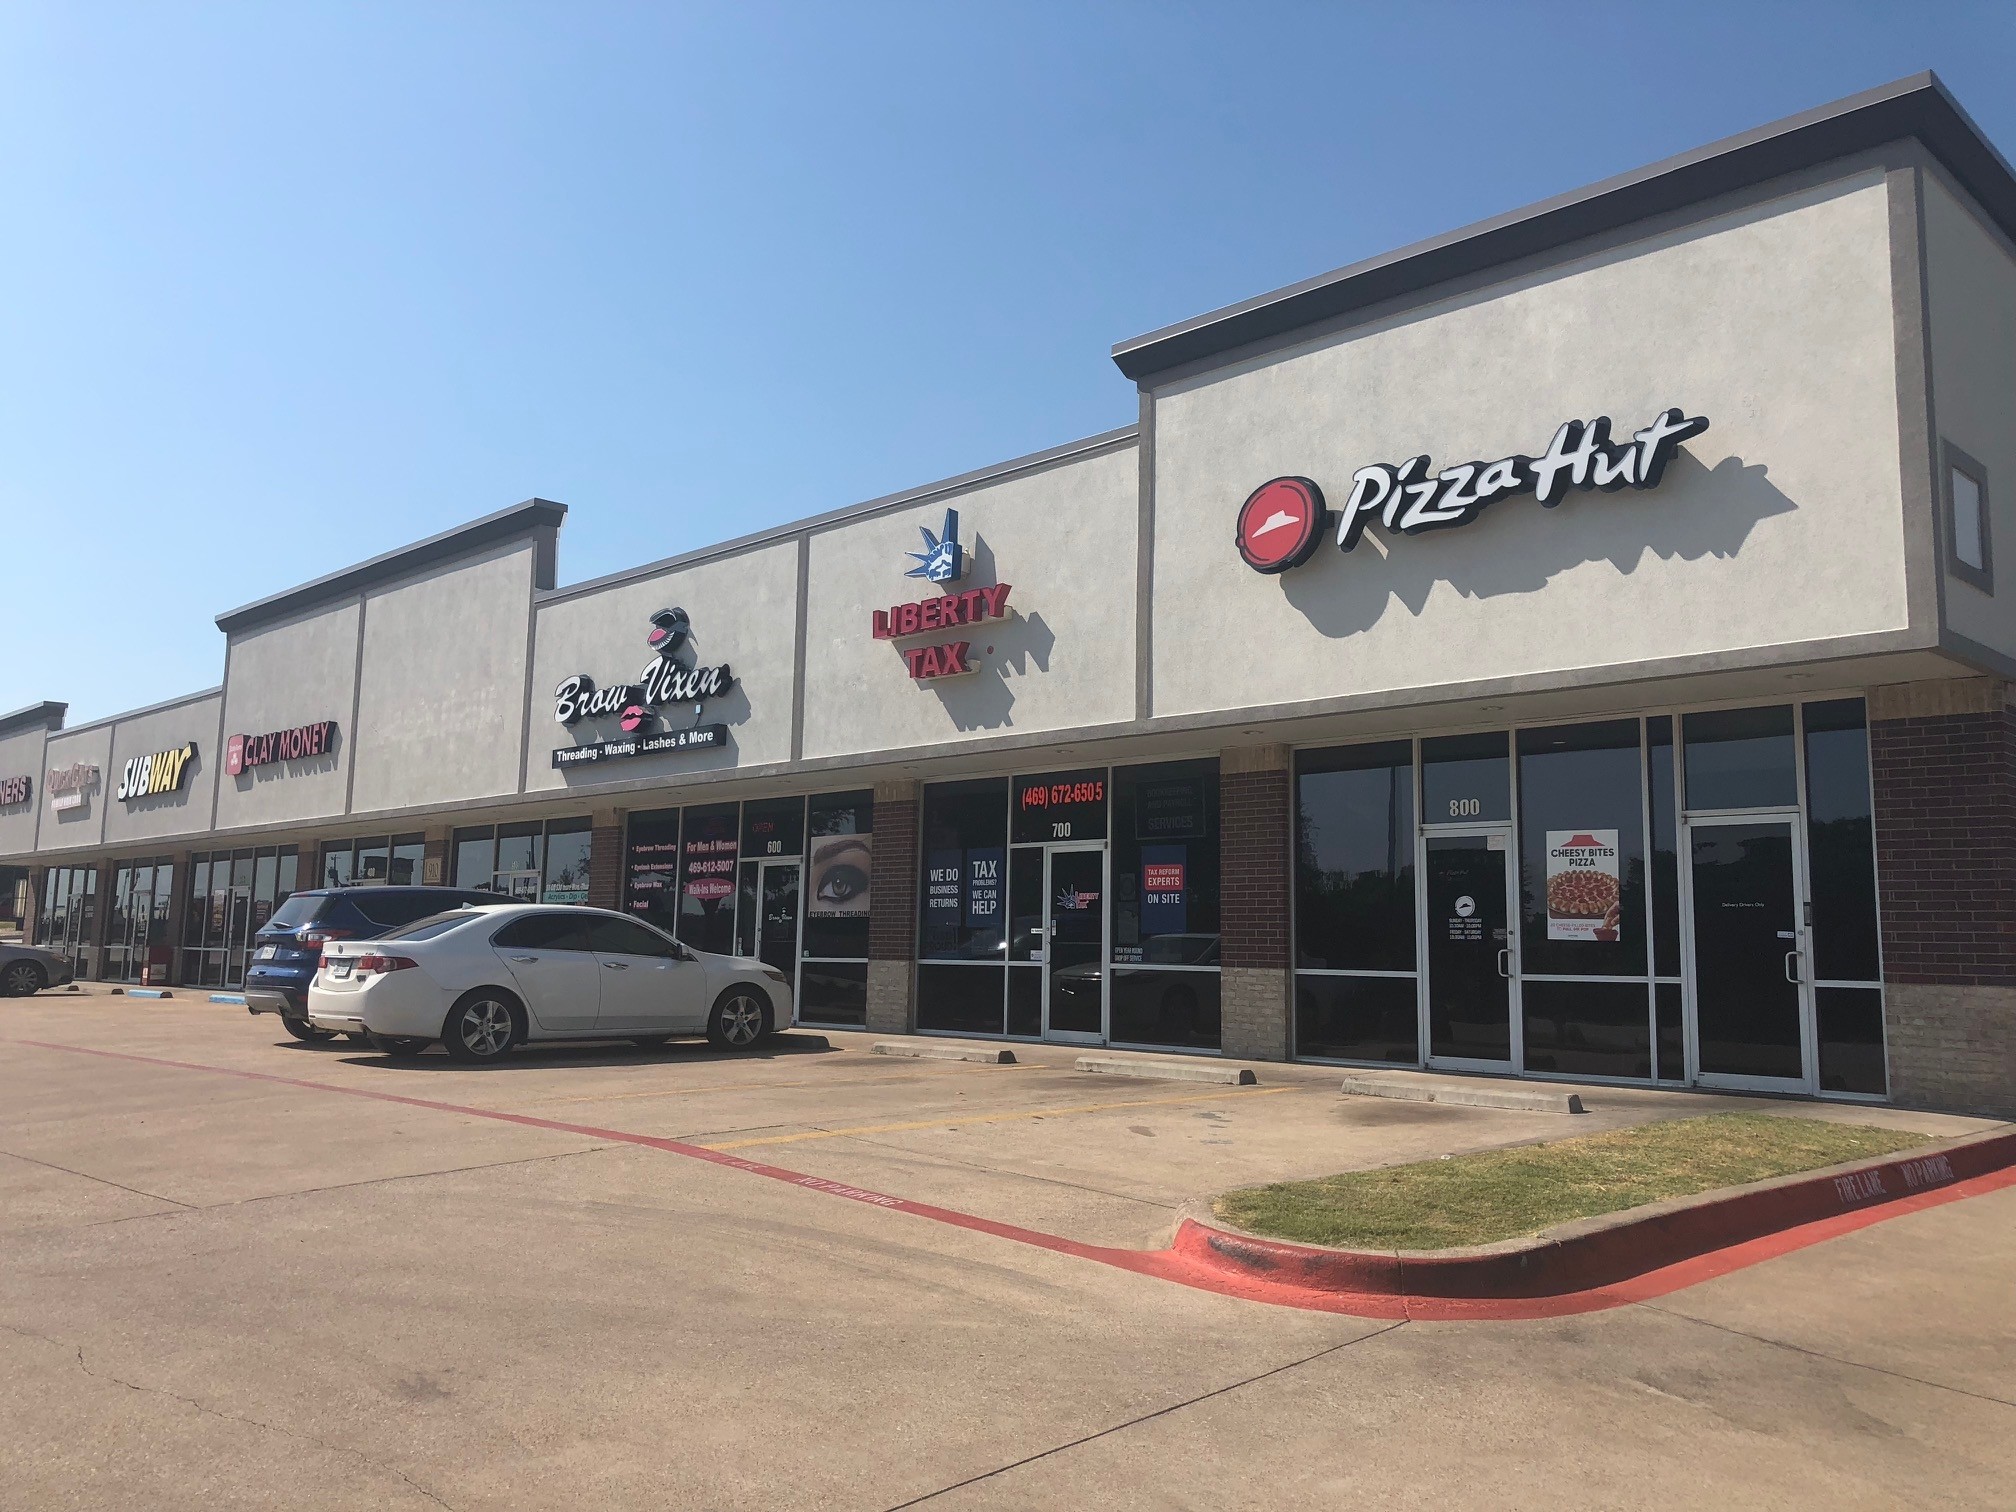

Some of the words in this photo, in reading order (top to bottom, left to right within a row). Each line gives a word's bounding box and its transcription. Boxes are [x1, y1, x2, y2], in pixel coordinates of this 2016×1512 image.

[1337, 457, 1523, 548] Pizza
[1529, 411, 1698, 502] Hut
[873, 583, 1009, 639] LIBERTY
[904, 641, 967, 678] TAX
[554, 675, 628, 723] Brow
[640, 655, 722, 705] Vixen
[245, 733, 275, 766] CLAY
[279, 721, 330, 760] MONEY
[556, 749, 598, 762] Threading
[605, 742, 636, 756] Waxing
[643, 736, 676, 750] Lashes
[679, 733, 686, 745] &
[689, 731, 714, 744] More
[118, 742, 194, 800] SUBWAY
[1022, 786, 1048, 811] (469)
[1052, 782, 1103, 804] 672-6505
[1450, 799, 1480, 816] 800
[1052, 822, 1071, 838] 700
[687, 842, 696, 852] For
[697, 842, 709, 851] Men
[716, 841, 737, 850] Women
[767, 841, 782, 853] 600
[1551, 849, 1586, 857] CHEESY
[1588, 848, 1614, 857] BITES
[973, 860, 997, 878] TAX
[1569, 858, 1595, 866] PIZZA
[930, 869, 943, 881] WE
[946, 869, 958, 881] DO
[1148, 877, 1180, 886] EXPERTS
[929, 885, 958, 894] BUSINESS
[972, 890, 982, 899] WE
[983, 890, 996, 899] CAN
[929, 898, 958, 908] RETURNS
[1148, 894, 1159, 903] ON
[1162, 893, 1180, 903] SITE
[972, 901, 997, 915] HELP
[1834, 1175, 1861, 1202] FIRE
[1855, 1170, 1887, 1199] LANE
